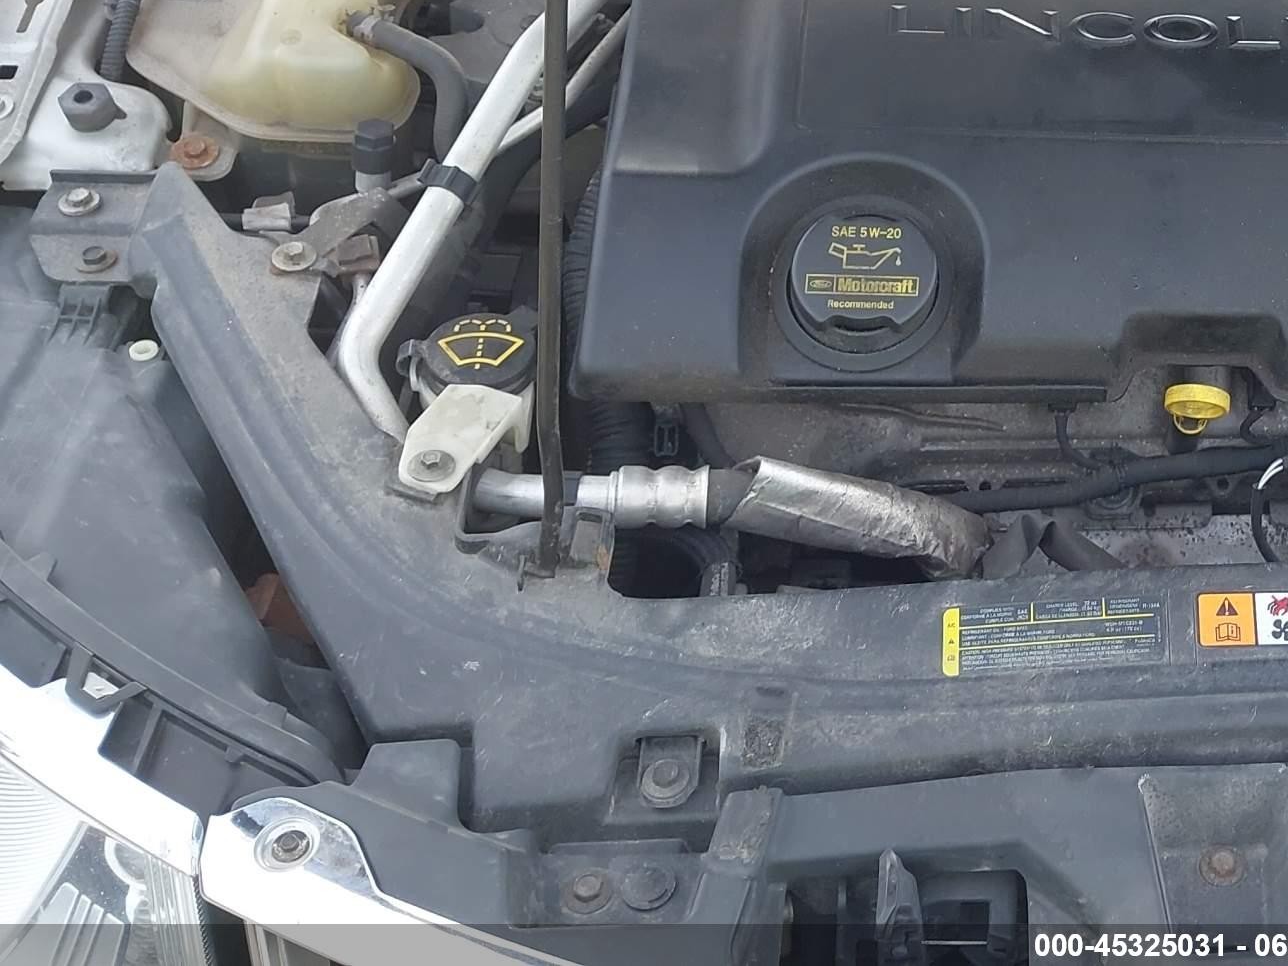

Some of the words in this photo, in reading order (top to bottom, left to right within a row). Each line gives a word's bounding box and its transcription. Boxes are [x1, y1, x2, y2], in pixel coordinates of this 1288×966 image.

[831, 226, 856, 238] SAE
[860, 227, 902, 239] 5W-20
[837, 276, 911, 294] Motorcraft
[828, 299, 894, 310] Recommended
